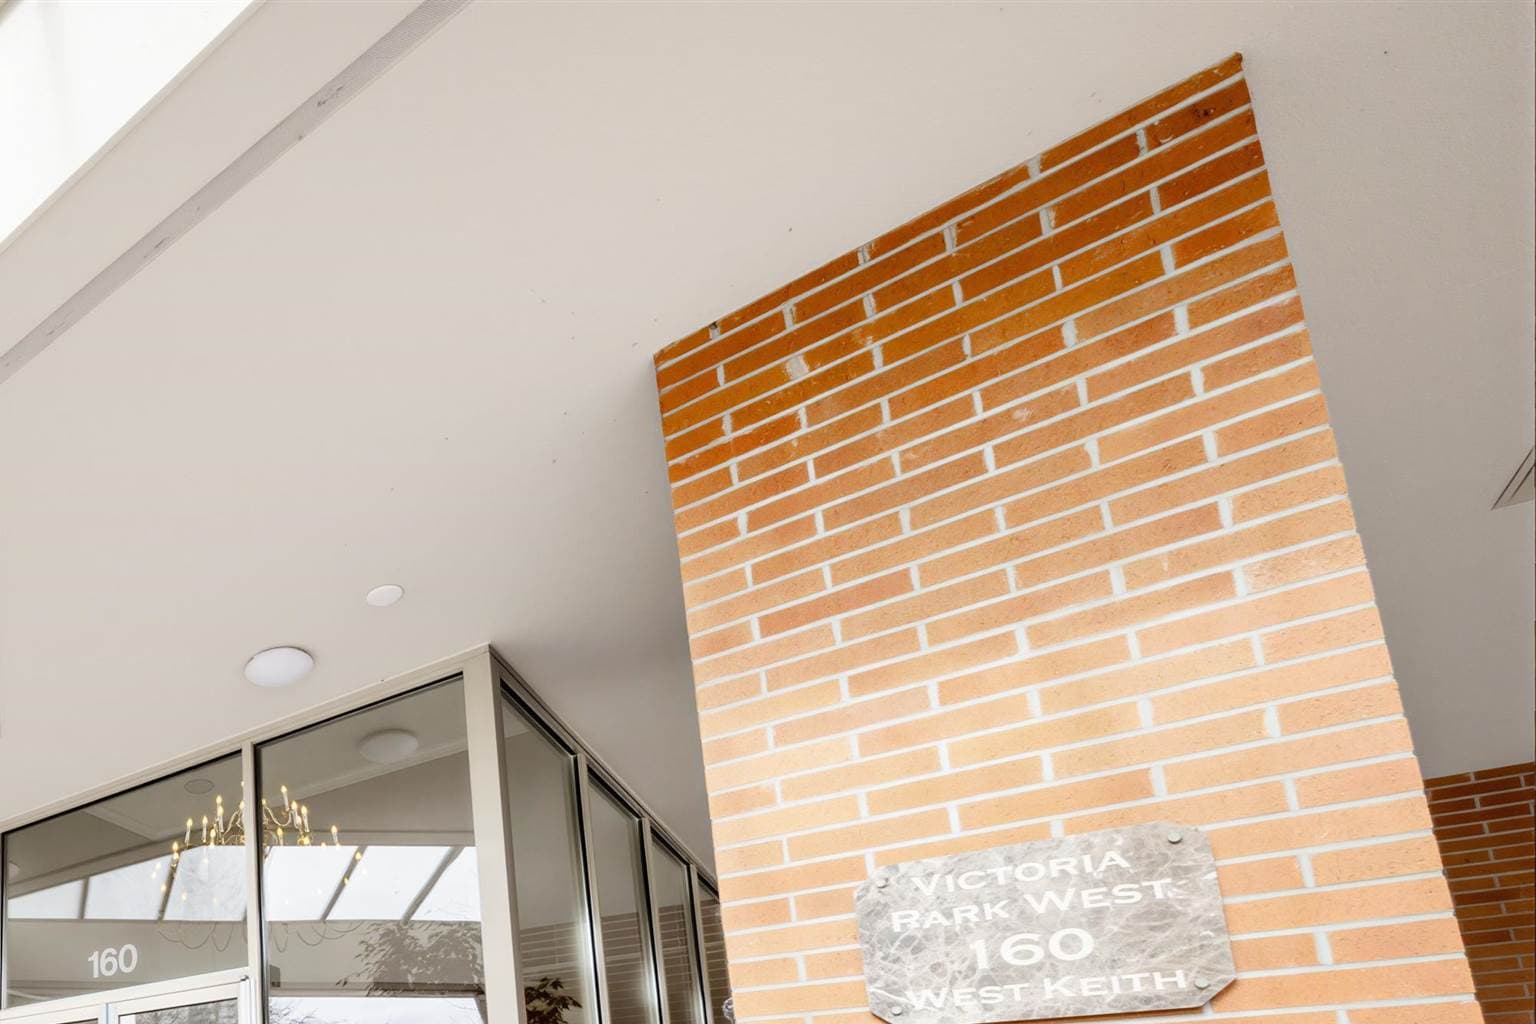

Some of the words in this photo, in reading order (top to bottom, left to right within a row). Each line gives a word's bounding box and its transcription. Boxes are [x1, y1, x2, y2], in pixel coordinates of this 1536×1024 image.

[910, 850, 1131, 896] VICTORIA
[891, 900, 1010, 932] PARK
[1023, 878, 1172, 914] WEST
[87, 943, 138, 978] 160
[969, 928, 1094, 969] 160
[905, 983, 1030, 1009] WEST
[1043, 969, 1186, 999] KEITH
